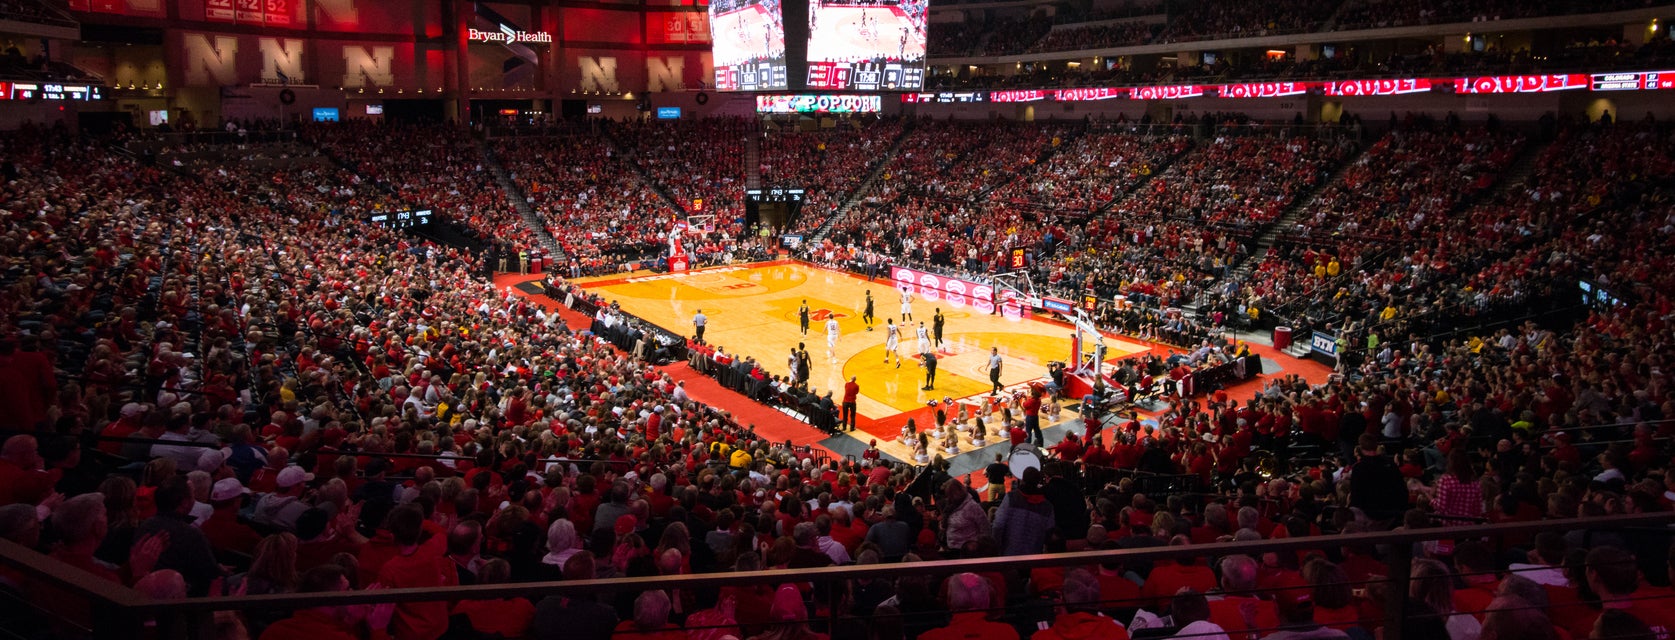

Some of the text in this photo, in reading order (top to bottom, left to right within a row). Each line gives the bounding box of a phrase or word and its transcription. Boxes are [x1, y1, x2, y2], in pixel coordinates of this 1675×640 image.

[468, 28, 553, 43] Bryan Health
[184, 32, 239, 87] N
[259, 37, 305, 84] N
[343, 46, 394, 87] N
[578, 56, 620, 92] N
[647, 56, 685, 92] N
[804, 95, 879, 110] POPCORN
[1013, 255, 1023, 267] 30
[1313, 334, 1335, 353] BTN
